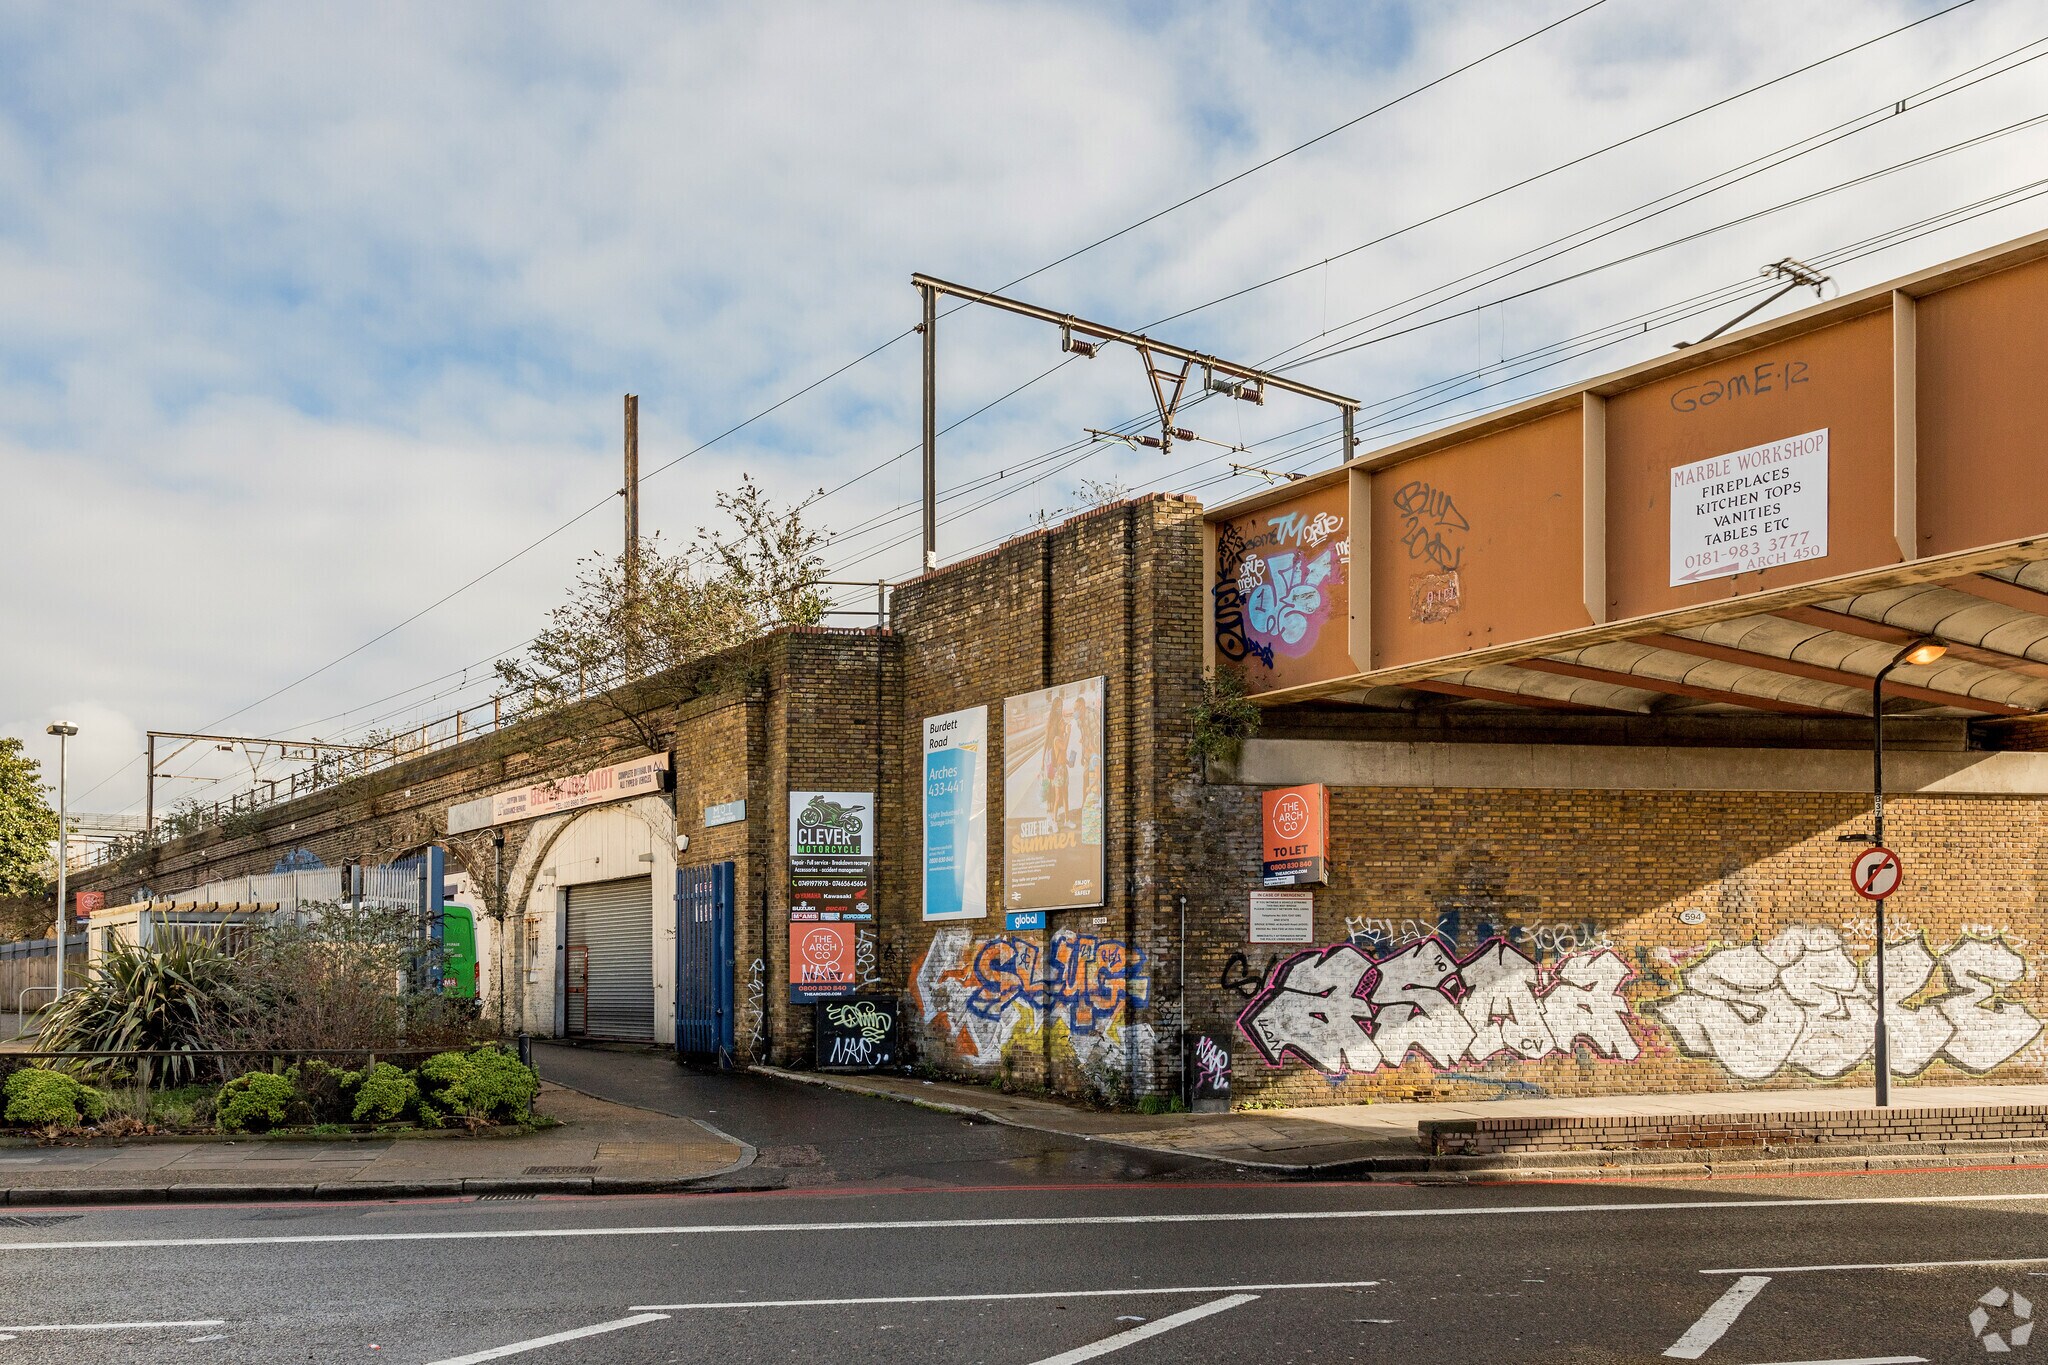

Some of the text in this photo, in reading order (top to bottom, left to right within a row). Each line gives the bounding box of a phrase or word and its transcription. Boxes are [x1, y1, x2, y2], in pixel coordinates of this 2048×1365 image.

[1674, 434, 1824, 487] MARBLE WORKSHOP
[1702, 467, 1790, 498] FIREPLACES
[1696, 481, 1801, 516] KITCHEN TOPS
[1713, 502, 1781, 527] VANITIES
[1705, 517, 1790, 546] TABLES ETC
[1685, 531, 1810, 569] 0181-983 3777
[1746, 545, 1820, 570] ARCH 450
[929, 719, 958, 734] Burdett
[929, 735, 949, 749] Road
[588, 767, 614, 793] MOT
[928, 765, 958, 781] Arches
[928, 779, 964, 797] 433-441
[1282, 801, 1299, 812] THE
[1279, 811, 1303, 822] ARCH
[1020, 819, 1050, 838] SEIZE THE
[1283, 821, 1298, 832] CO
[798, 828, 852, 845] CLEVER
[1011, 831, 1077, 854] Summer
[797, 845, 860, 854] MOTORCYCLE
[1273, 845, 1309, 857] TO LET
[1299, 860, 1312, 868] 840
[1014, 913, 1037, 928] global
[1684, 913, 1702, 921] 594
[808, 943, 837, 951] ARCH
[812, 935, 832, 944] THE
[814, 951, 831, 960] CO
